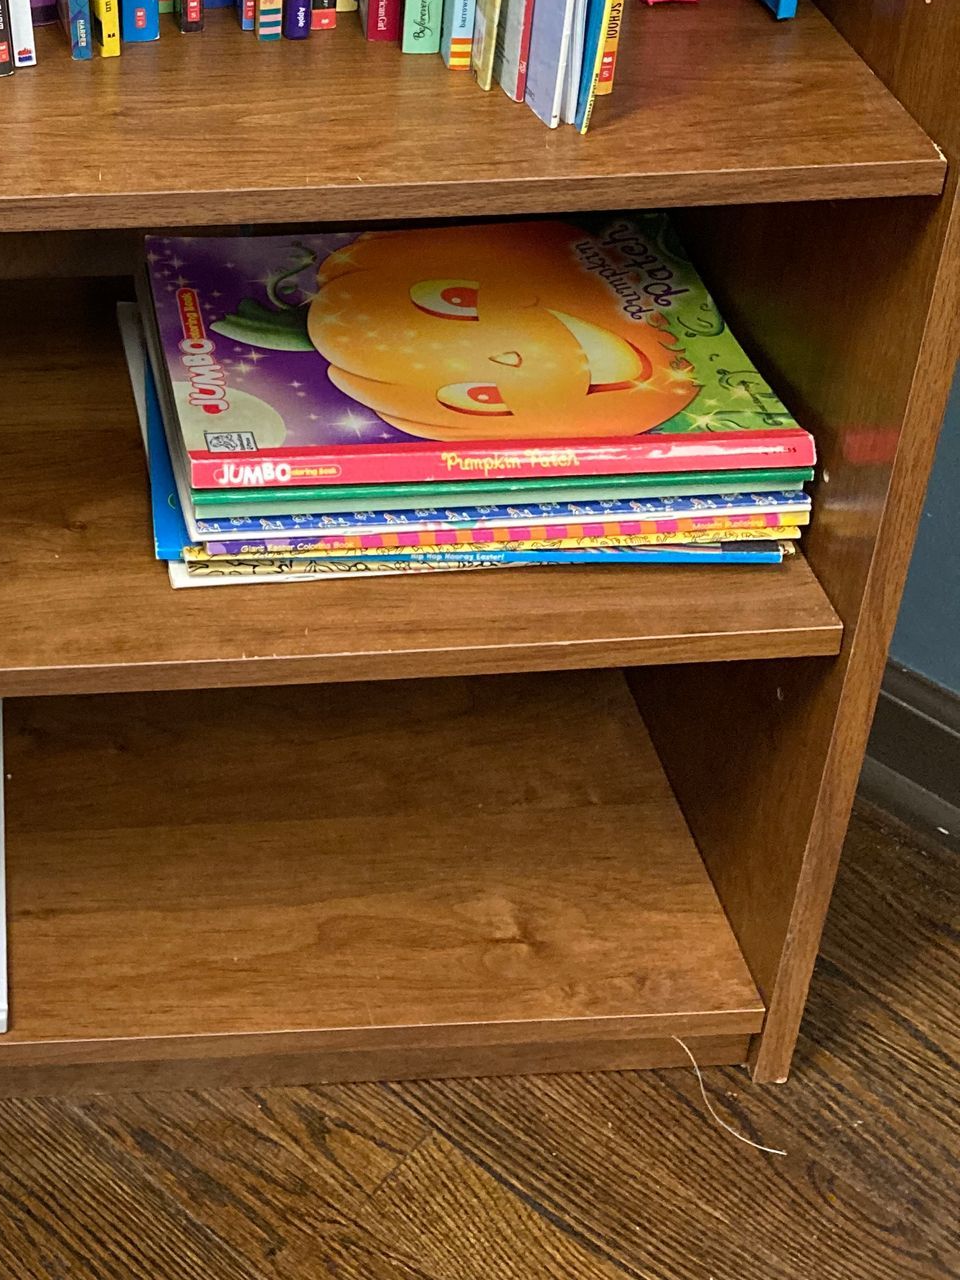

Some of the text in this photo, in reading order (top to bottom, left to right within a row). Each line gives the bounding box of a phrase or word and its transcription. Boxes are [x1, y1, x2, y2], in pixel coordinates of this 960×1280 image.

[78, 20, 87, 47] HARPER
[179, 339, 230, 414] JUMBO
[218, 462, 291, 485] JUMBO
[442, 452, 521, 476] Pumpkin
